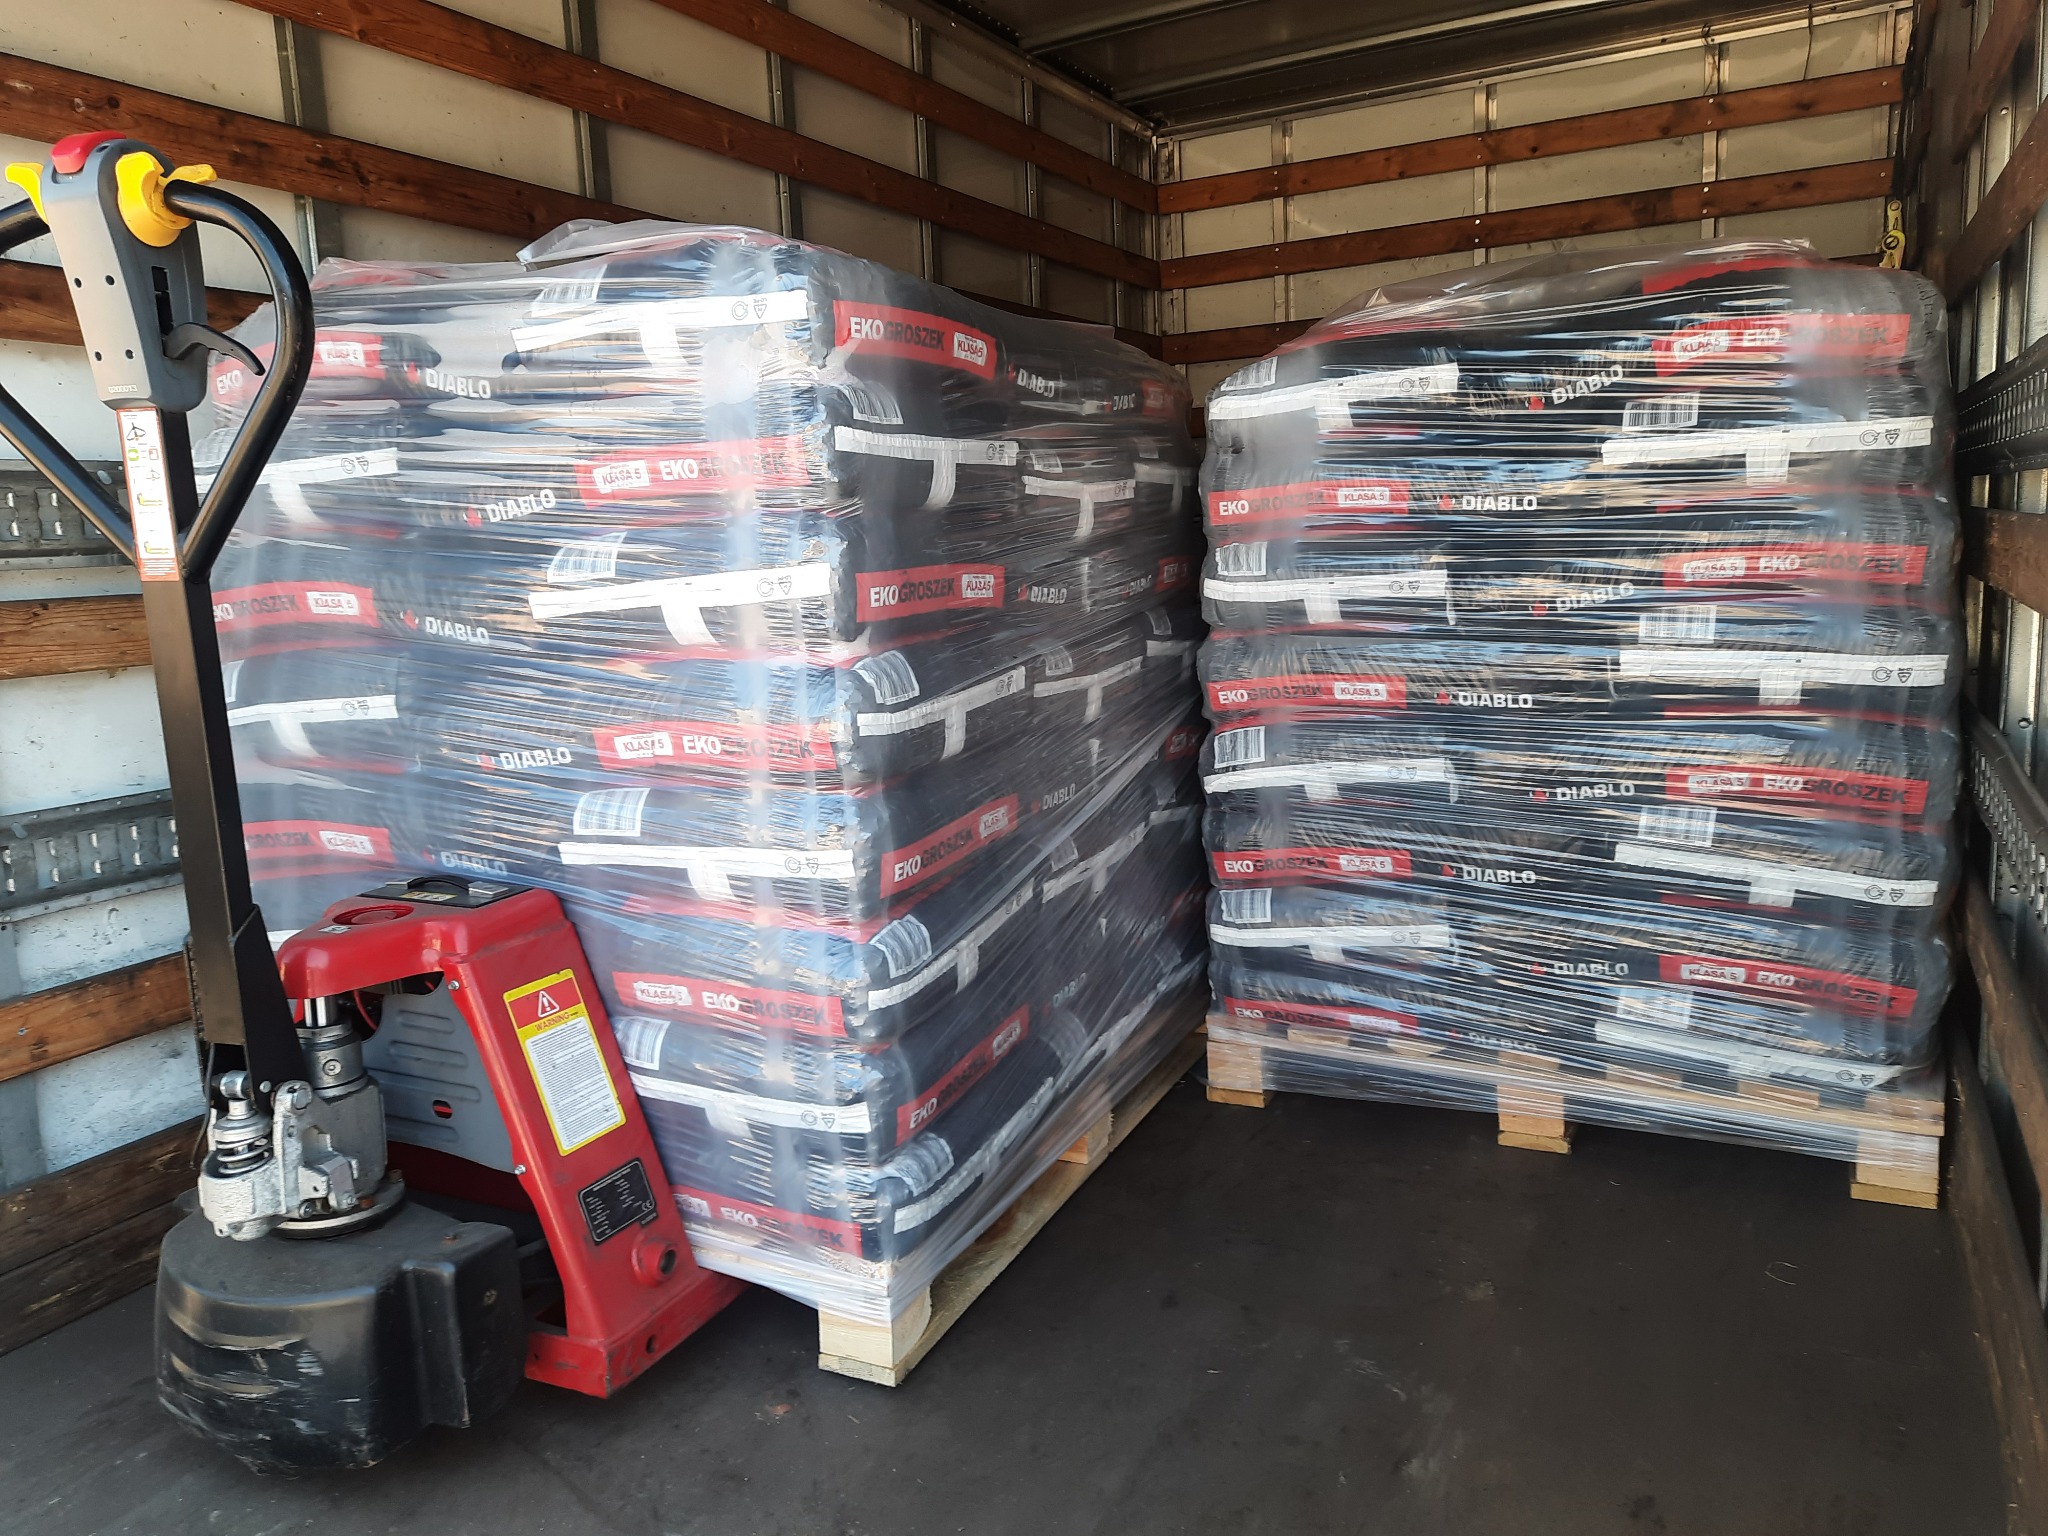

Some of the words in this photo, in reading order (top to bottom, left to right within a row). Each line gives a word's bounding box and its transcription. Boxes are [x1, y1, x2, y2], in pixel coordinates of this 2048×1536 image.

[850, 316, 945, 351] EKOGROSZEK
[1742, 325, 1888, 347] EKOROSZEK
[425, 369, 491, 399] DIABLO
[1552, 364, 1624, 405] DIABLO
[634, 467, 641, 480] 5
[486, 488, 556, 523] DIABLO
[1344, 493, 1377, 502] KLASA
[1379, 492, 1385, 501] 5
[1462, 495, 1537, 511] DIABLO
[1730, 562, 1737, 571] 5
[1758, 554, 1905, 575] EKOGROSZEK
[870, 577, 955, 608] EKOGROSZEK
[1030, 585, 1067, 604] DIABLO
[1556, 582, 1634, 611] DIABLO
[425, 616, 490, 645] DIABLO
[1218, 684, 1325, 704] EKOGROSZEK
[1340, 687, 1372, 697] KLASA
[1374, 688, 1381, 697] 5
[1458, 691, 1533, 708] DIABLO
[658, 738, 665, 749] 5
[499, 746, 572, 769] DIABLO
[1556, 782, 1635, 800] DIABLO
[1737, 777, 1745, 787] 5
[1763, 776, 1908, 804] EKOGROSZEK
[1043, 783, 1076, 810] DIABLO
[440, 851, 507, 876] DIABLO
[894, 827, 973, 882] EKOGROSZEK
[1224, 857, 1329, 873] EKOGROSZEK
[1380, 860, 1386, 869] 5
[1462, 867, 1537, 884] DIABLO
[1554, 962, 1629, 976] DIABLO
[1689, 968, 1727, 979] KLASA
[1730, 971, 1738, 980] 5
[640, 987, 676, 999] KLASA
[1757, 970, 1896, 1008] EKOGROSZEK
[702, 991, 828, 1026] EKOGROSZEK
[535, 1012, 570, 1031] WARNING
